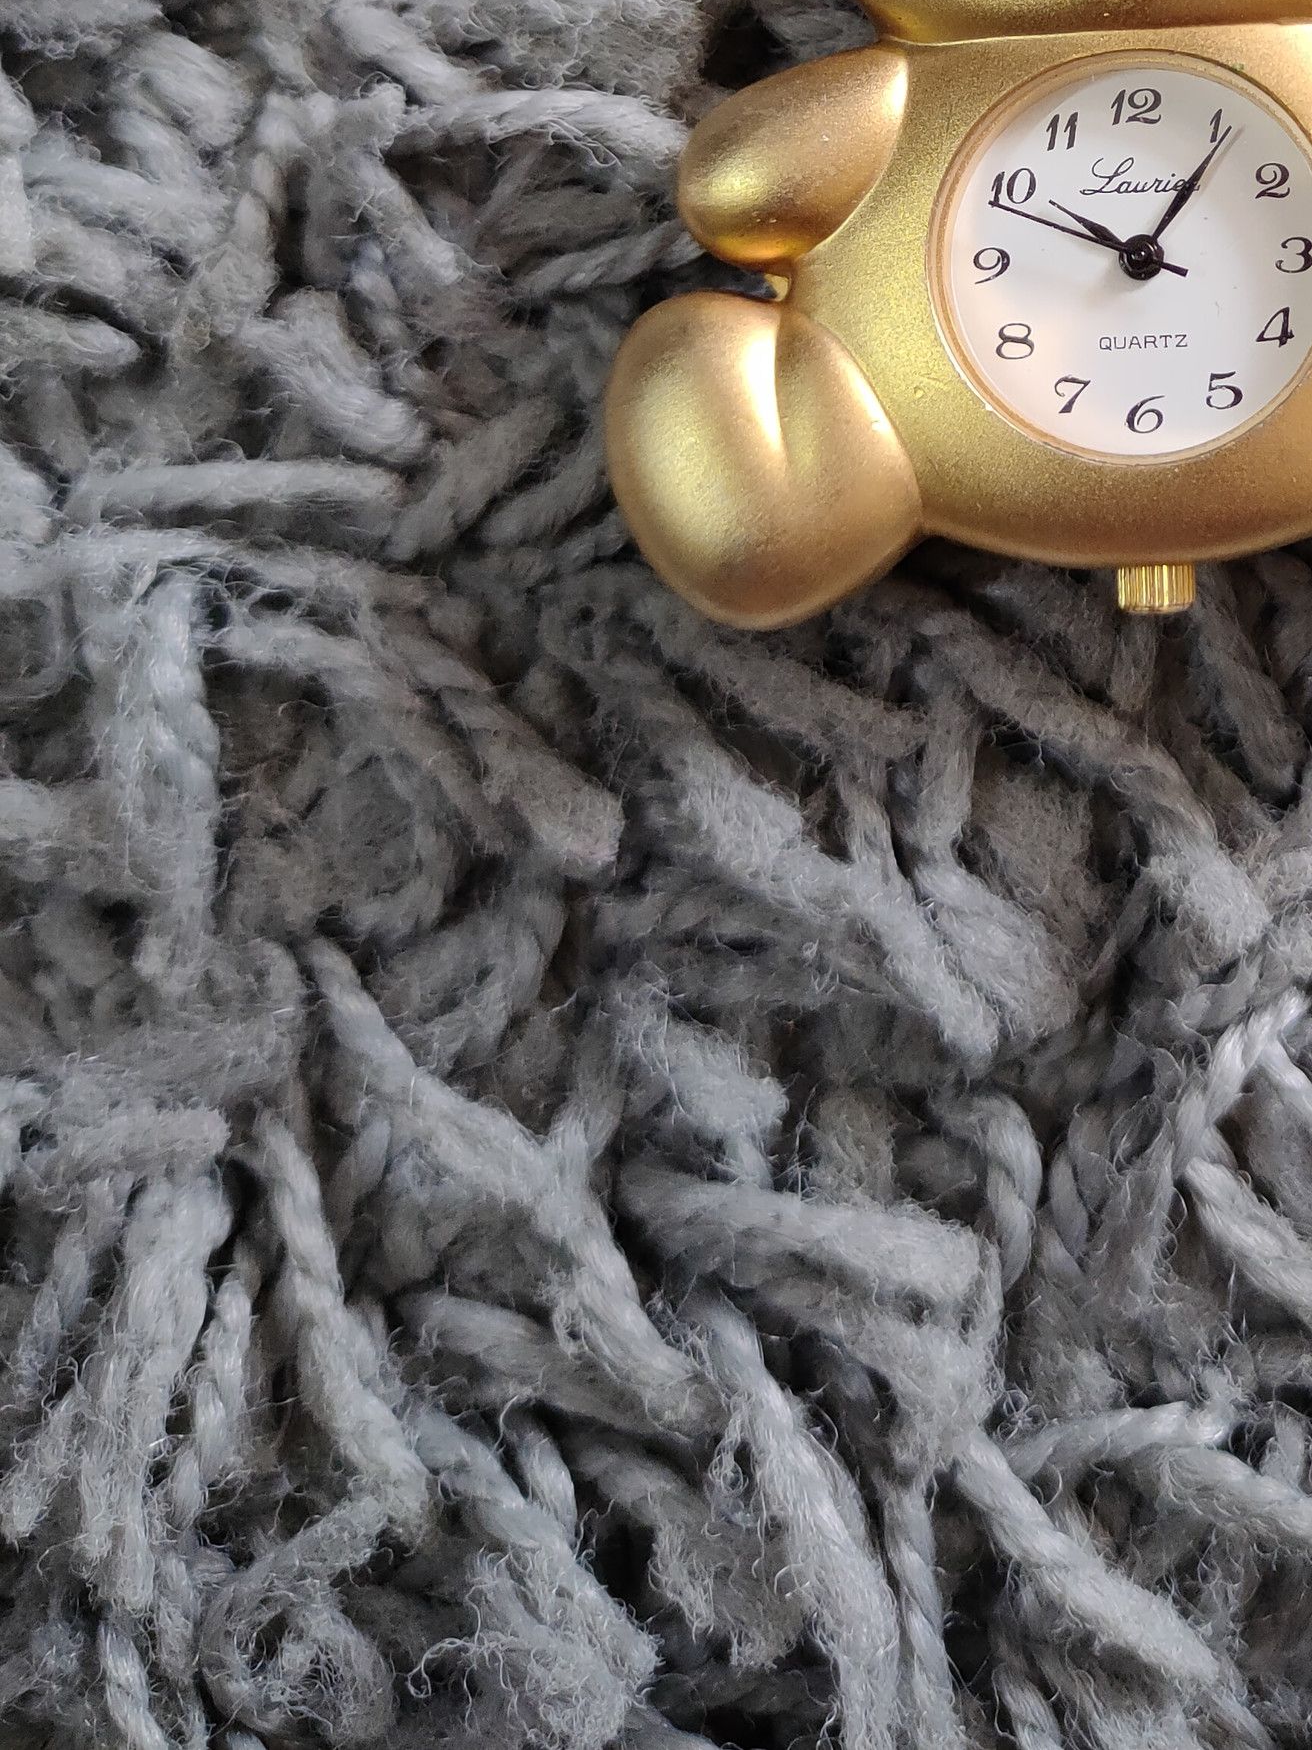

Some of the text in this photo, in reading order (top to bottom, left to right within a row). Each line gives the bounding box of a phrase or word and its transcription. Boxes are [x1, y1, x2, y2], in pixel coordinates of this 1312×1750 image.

[1110, 87, 1162, 126] 12
[1209, 108, 1223, 143] 1
[1045, 112, 1078, 151] 11
[990, 168, 1036, 205] 10
[1255, 162, 1290, 200] 2
[973, 247, 1011, 285] 9
[995, 323, 1034, 360] 8
[1099, 334, 1188, 351] QUARTZ
[1255, 307, 1295, 348] 4
[1054, 375, 1091, 414] 7
[1205, 371, 1243, 410] 5
[1126, 395, 1165, 434] 6
